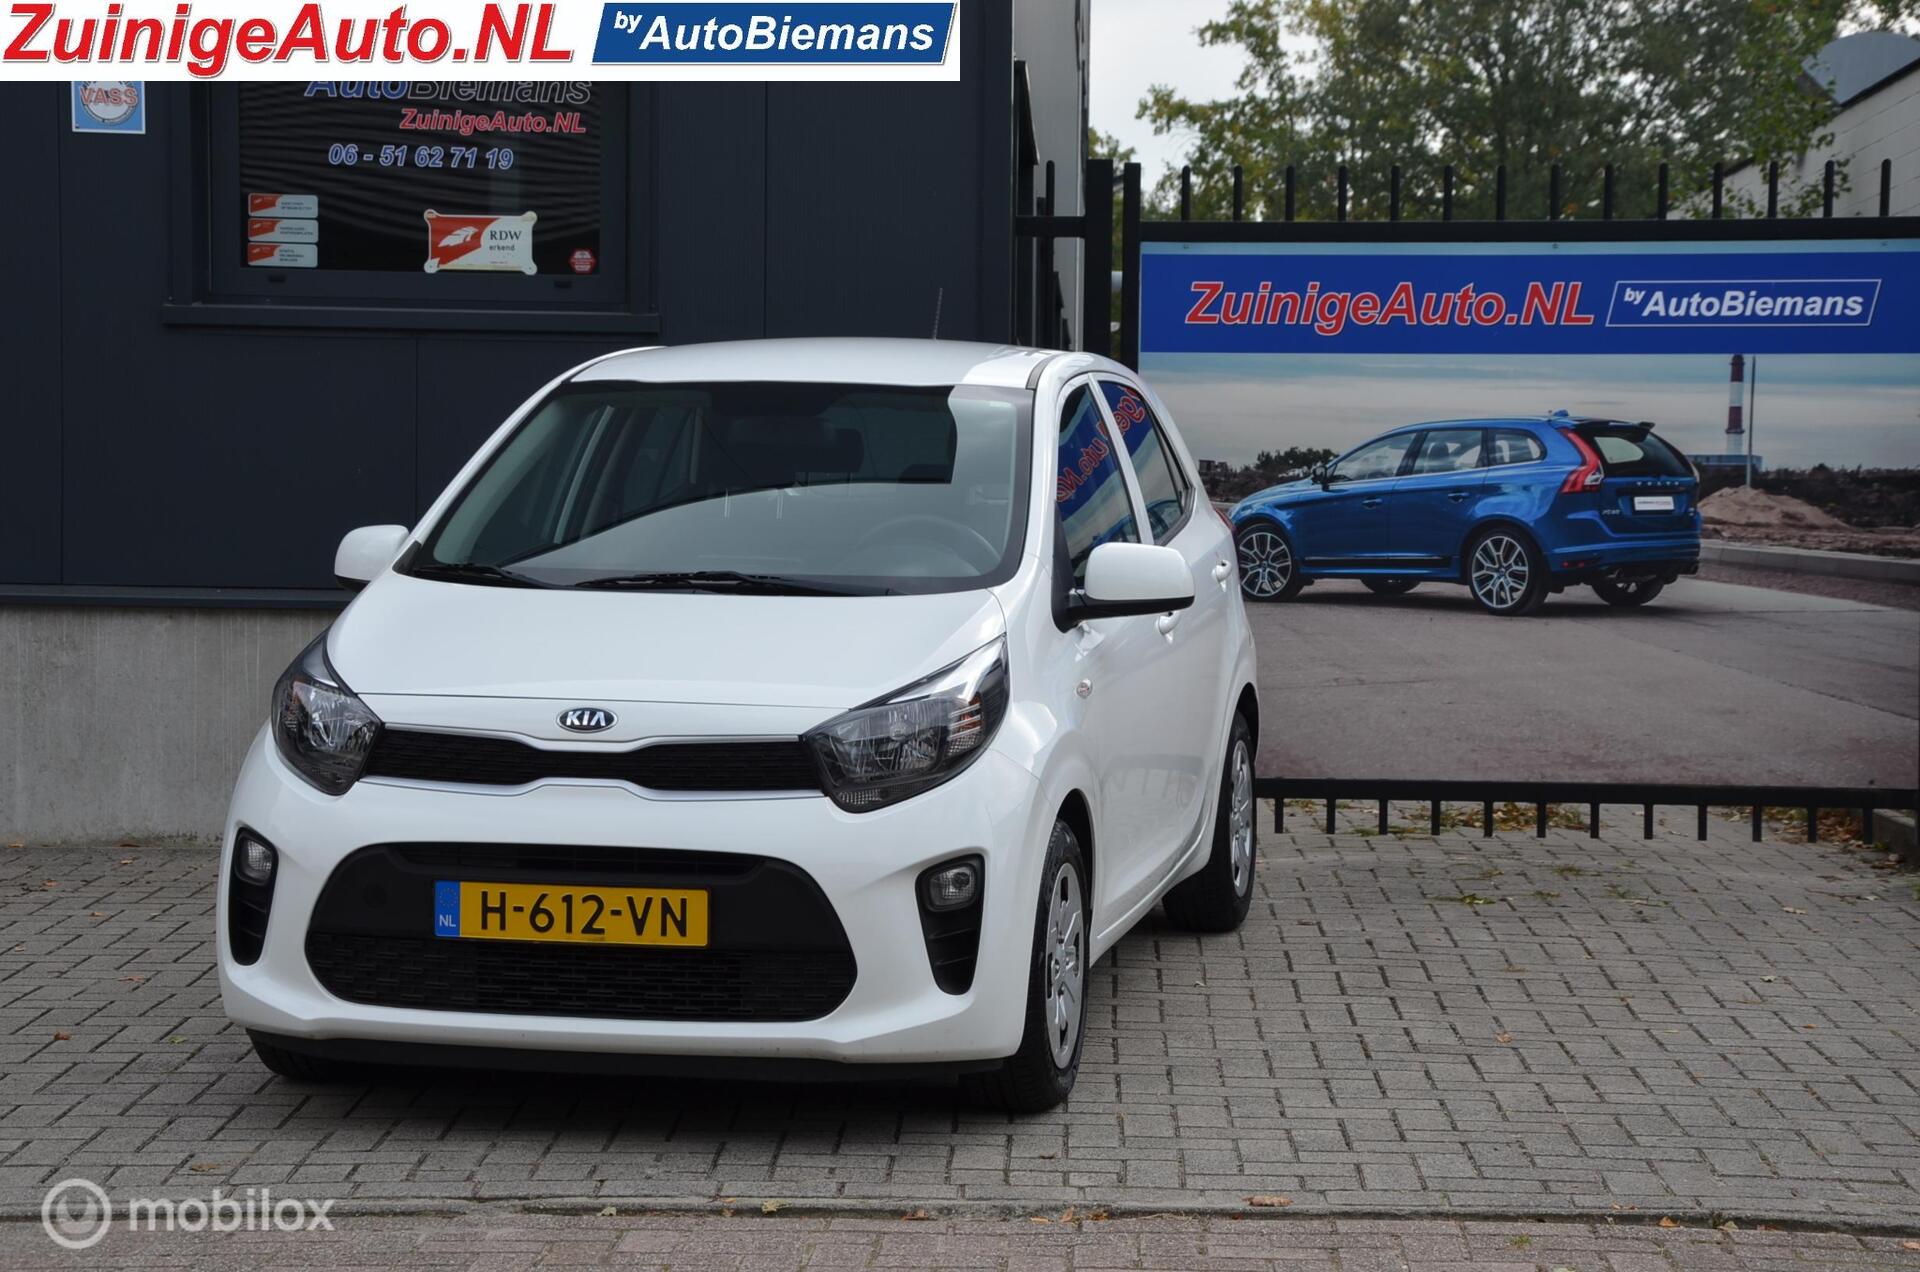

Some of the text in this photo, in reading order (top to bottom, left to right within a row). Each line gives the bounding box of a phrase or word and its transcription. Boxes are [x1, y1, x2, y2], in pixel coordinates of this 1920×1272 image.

[80, 87, 138, 107] VASS
[399, 108, 586, 135] ZuinigeAuto.NL
[328, 144, 357, 166] 06
[379, 145, 408, 167] 51
[415, 145, 443, 168] 62
[450, 146, 477, 168] 71
[485, 148, 513, 170] 19
[489, 230, 522, 241] RDW
[489, 244, 516, 252] erkend
[1185, 280, 1594, 336] ZuinigeAuto.NL
[1623, 287, 1865, 317] by AutoBiemans
[566, 711, 606, 727] KIA
[439, 890, 688, 938] NL H-612-VN
